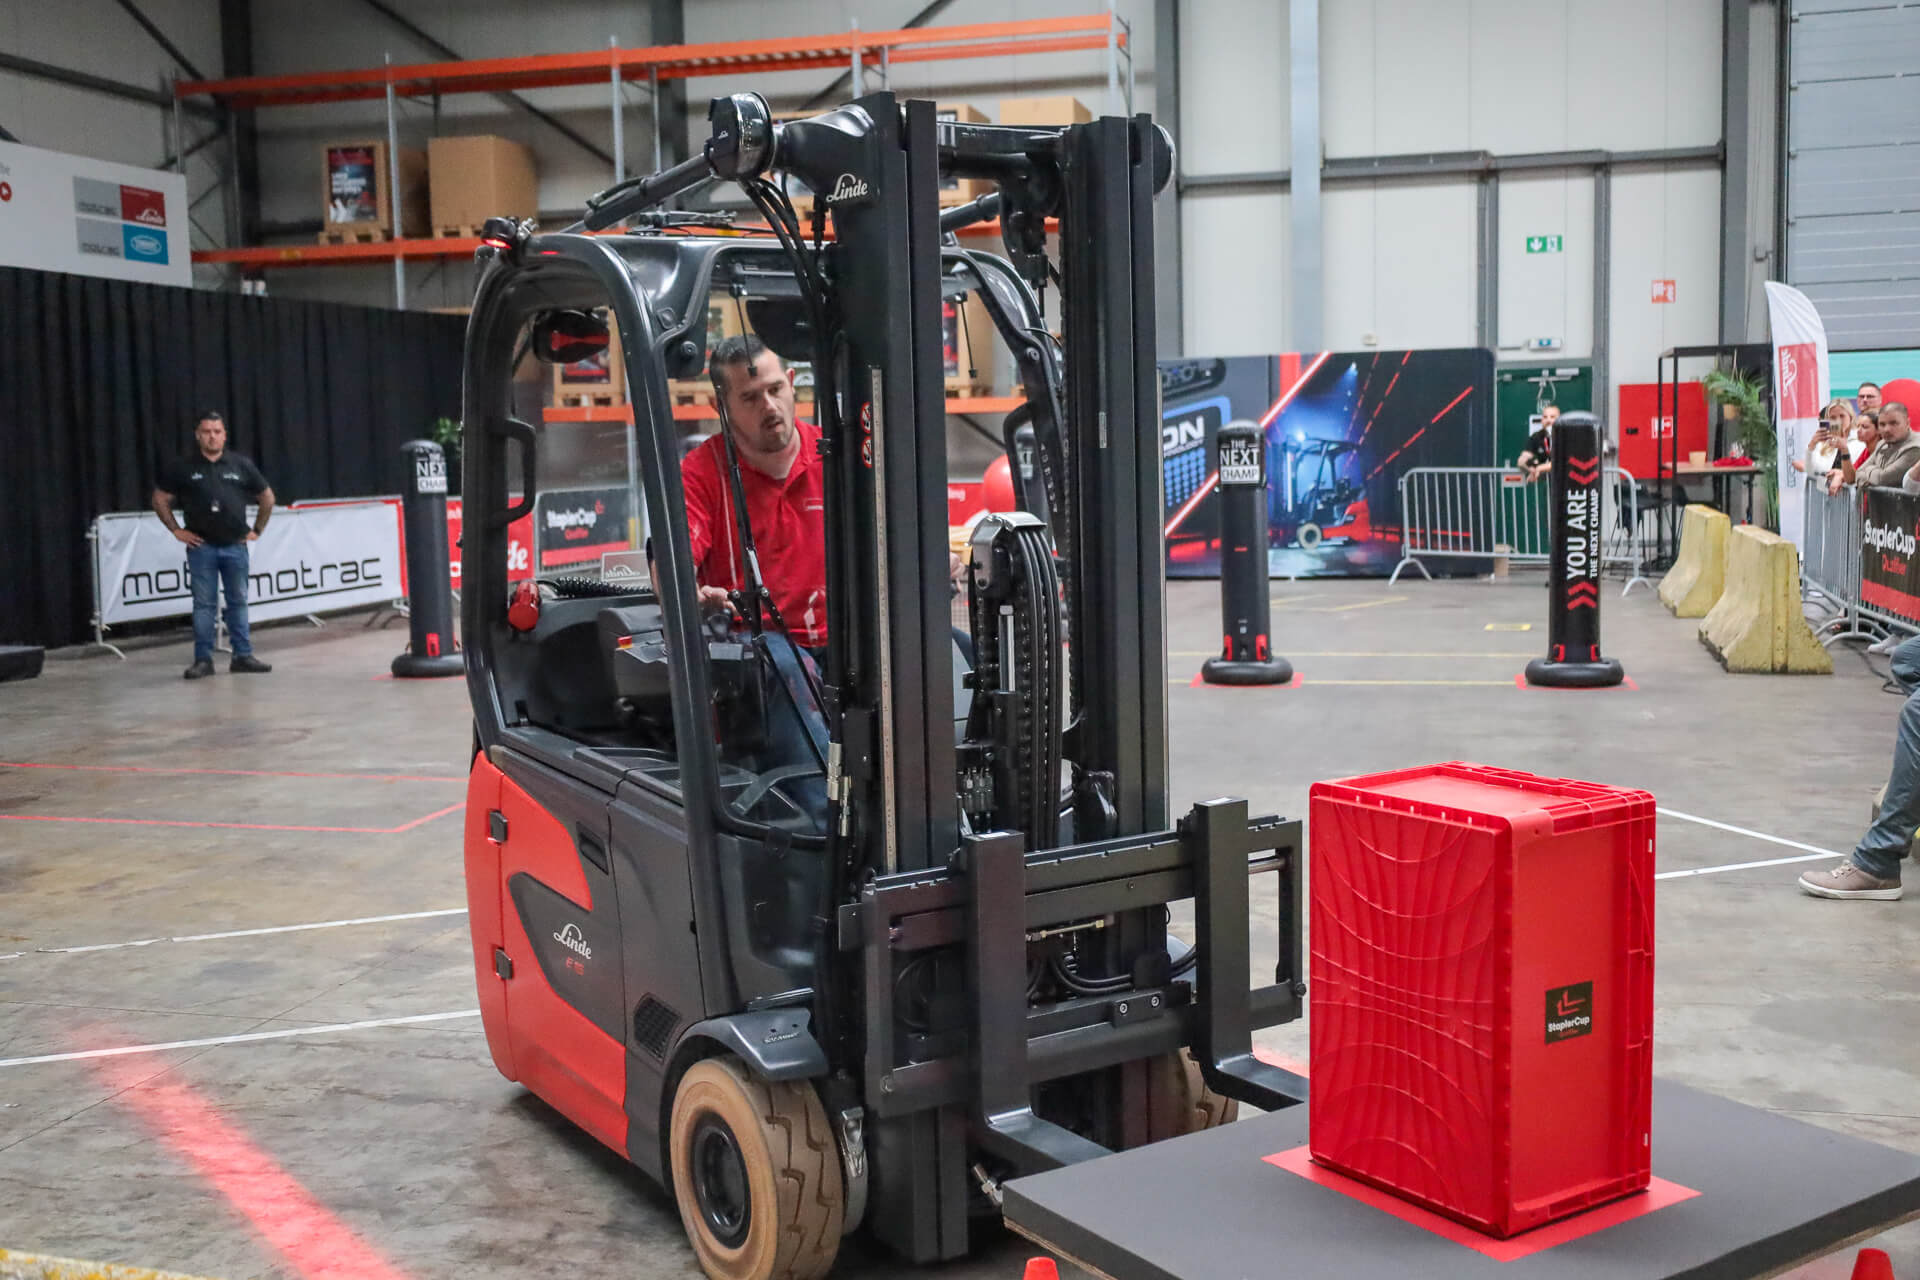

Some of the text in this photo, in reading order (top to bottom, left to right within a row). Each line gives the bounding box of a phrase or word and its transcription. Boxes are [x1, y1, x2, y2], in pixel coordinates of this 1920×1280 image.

[826, 173, 868, 203] Linde
[1231, 440, 1246, 449] THE
[1220, 449, 1260, 466] NEXT
[416, 462, 447, 477] NEX
[1222, 469, 1258, 480] CHAMP
[1567, 489, 1587, 580] YOU ARE
[1590, 487, 1599, 578] THE NEXT CHAMP
[1865, 519, 1916, 560] StaplerCup
[553, 923, 592, 960] Linde
[1548, 1016, 1590, 1033] StaplerCup
